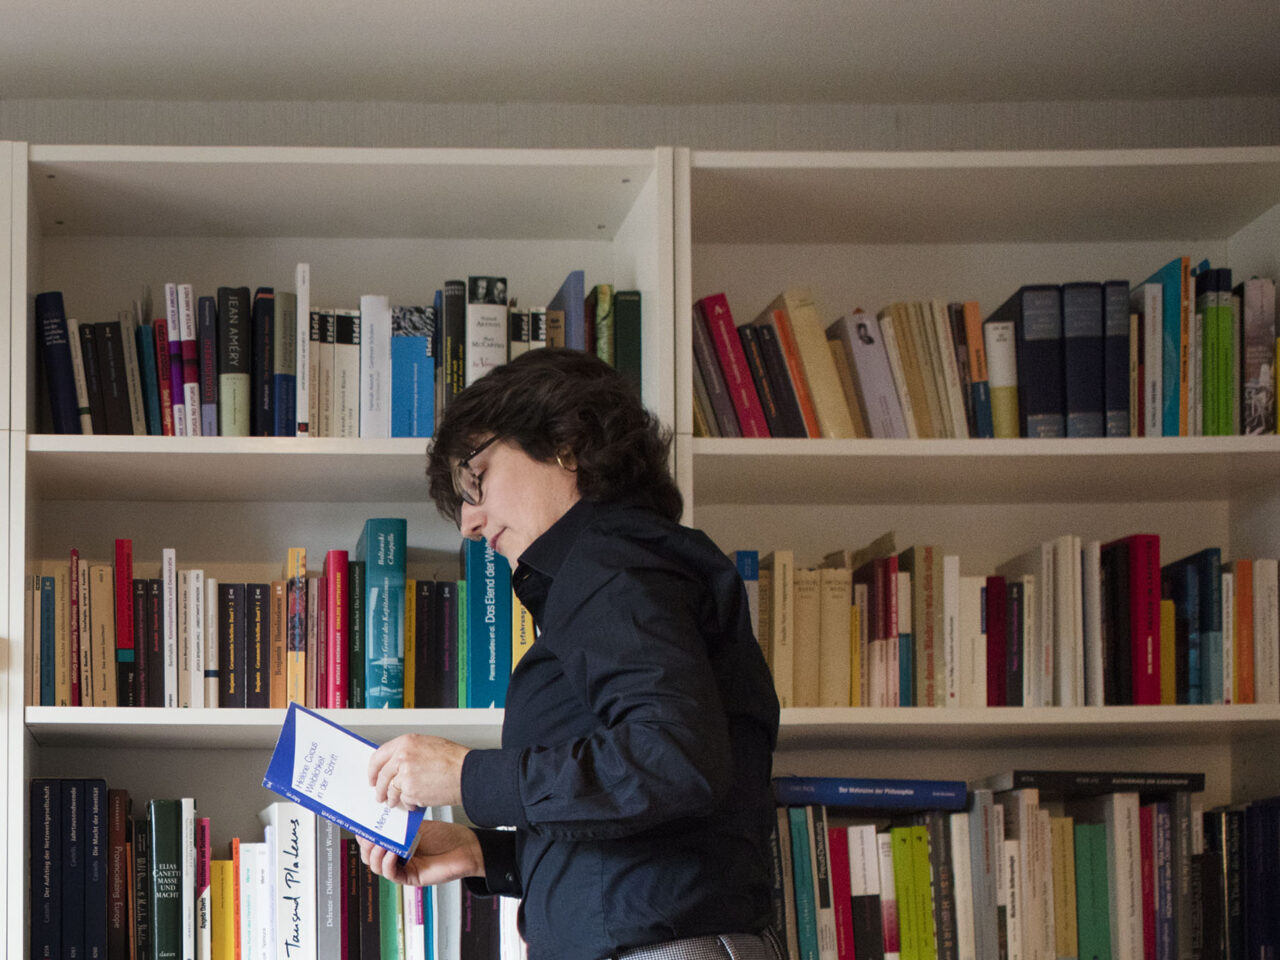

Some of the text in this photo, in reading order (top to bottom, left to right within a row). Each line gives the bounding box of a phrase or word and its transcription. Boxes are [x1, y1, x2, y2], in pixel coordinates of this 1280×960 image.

[228, 296, 240, 366] JEAN AMÉRY
[311, 314, 319, 341] PIPER
[326, 316, 334, 343] PIPER
[352, 318, 360, 344] PIPER
[485, 563, 496, 577] der
[485, 579, 496, 605] Elend
[485, 606, 496, 623] Das
[274, 598, 283, 675] Benjamin Illuminationen
[381, 577, 390, 683] Der Geist des Kapitalismus
[488, 639, 496, 664] Bourdieu
[488, 665, 496, 680] Pierre
[320, 777, 329, 791] der
[91, 787, 99, 814] Identität
[43, 786, 51, 849] Netzwerkgesellschaft
[43, 861, 51, 886] Aufstieg
[283, 818, 301, 957] Tausend Plateaus
[199, 913, 207, 929] Angela
